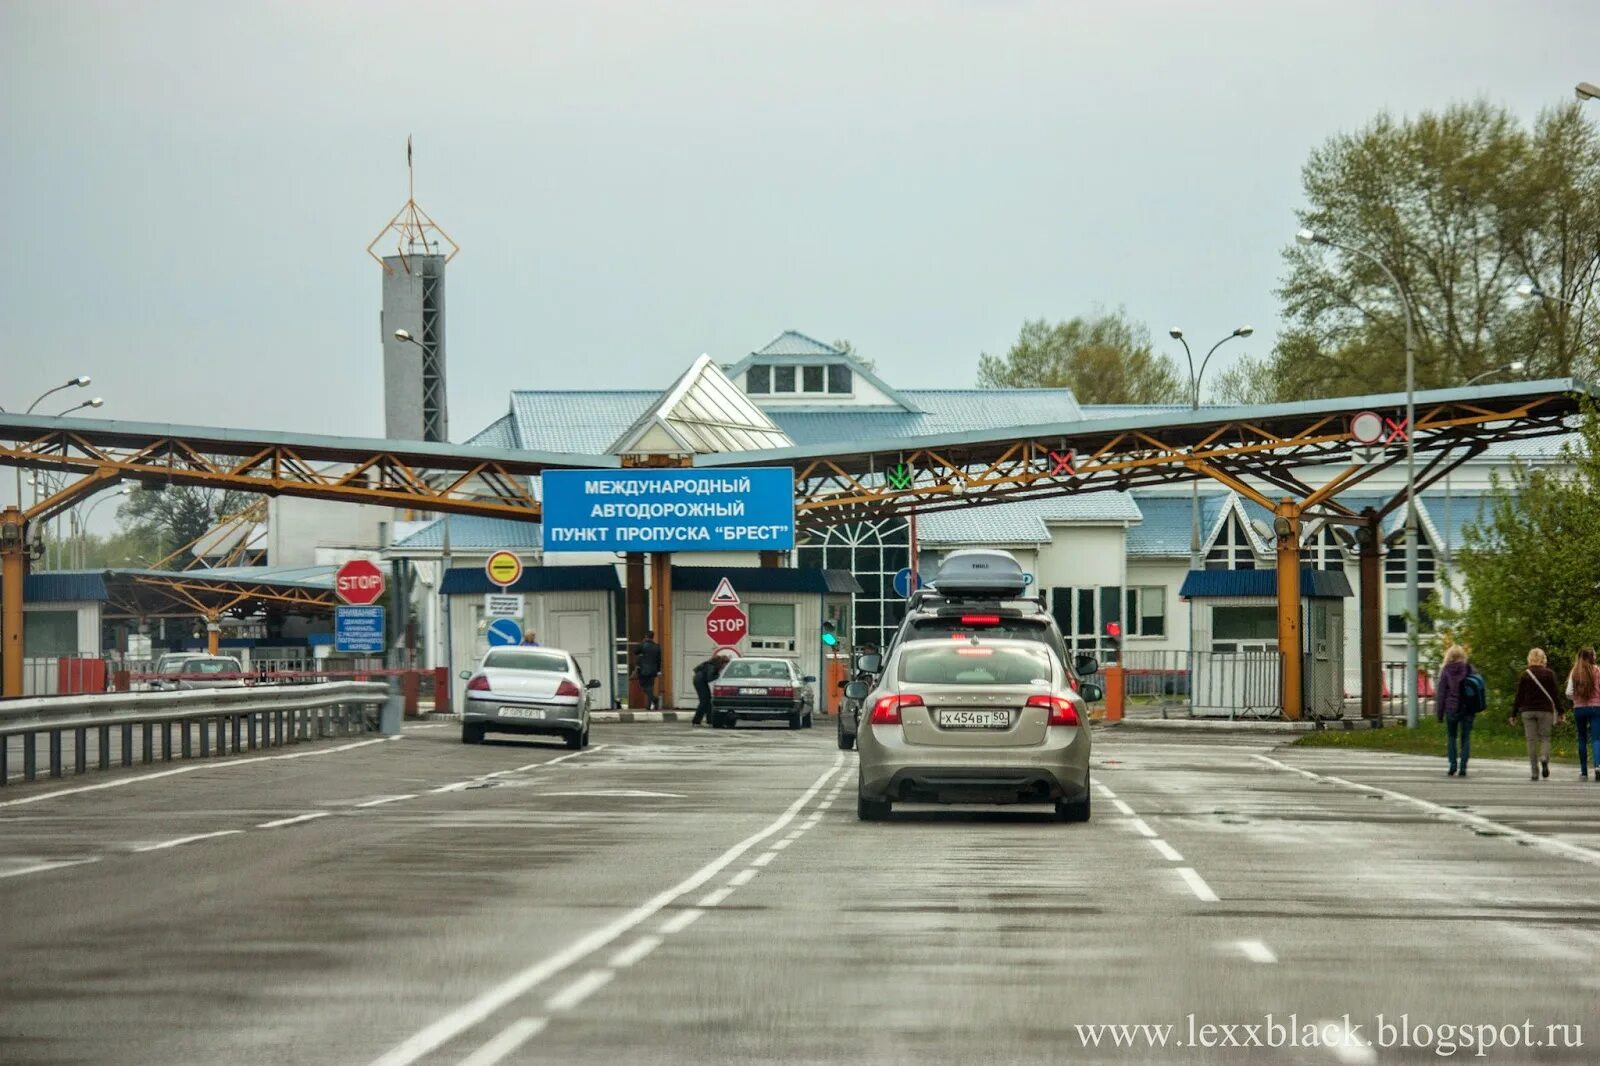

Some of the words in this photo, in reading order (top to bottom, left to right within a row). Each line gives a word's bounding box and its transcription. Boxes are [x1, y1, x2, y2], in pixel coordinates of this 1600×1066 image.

[584, 476, 750, 495] МЕЖДУНАРОДНЫЙ
[590, 500, 744, 519] АВТОДОРОЖНЫЙ
[551, 527, 608, 542] ПУНКТ
[616, 526, 710, 541] ПРОПУСКА
[339, 575, 381, 590] STOP
[708, 618, 744, 632] STOP
[993, 712, 1005, 720] 50
